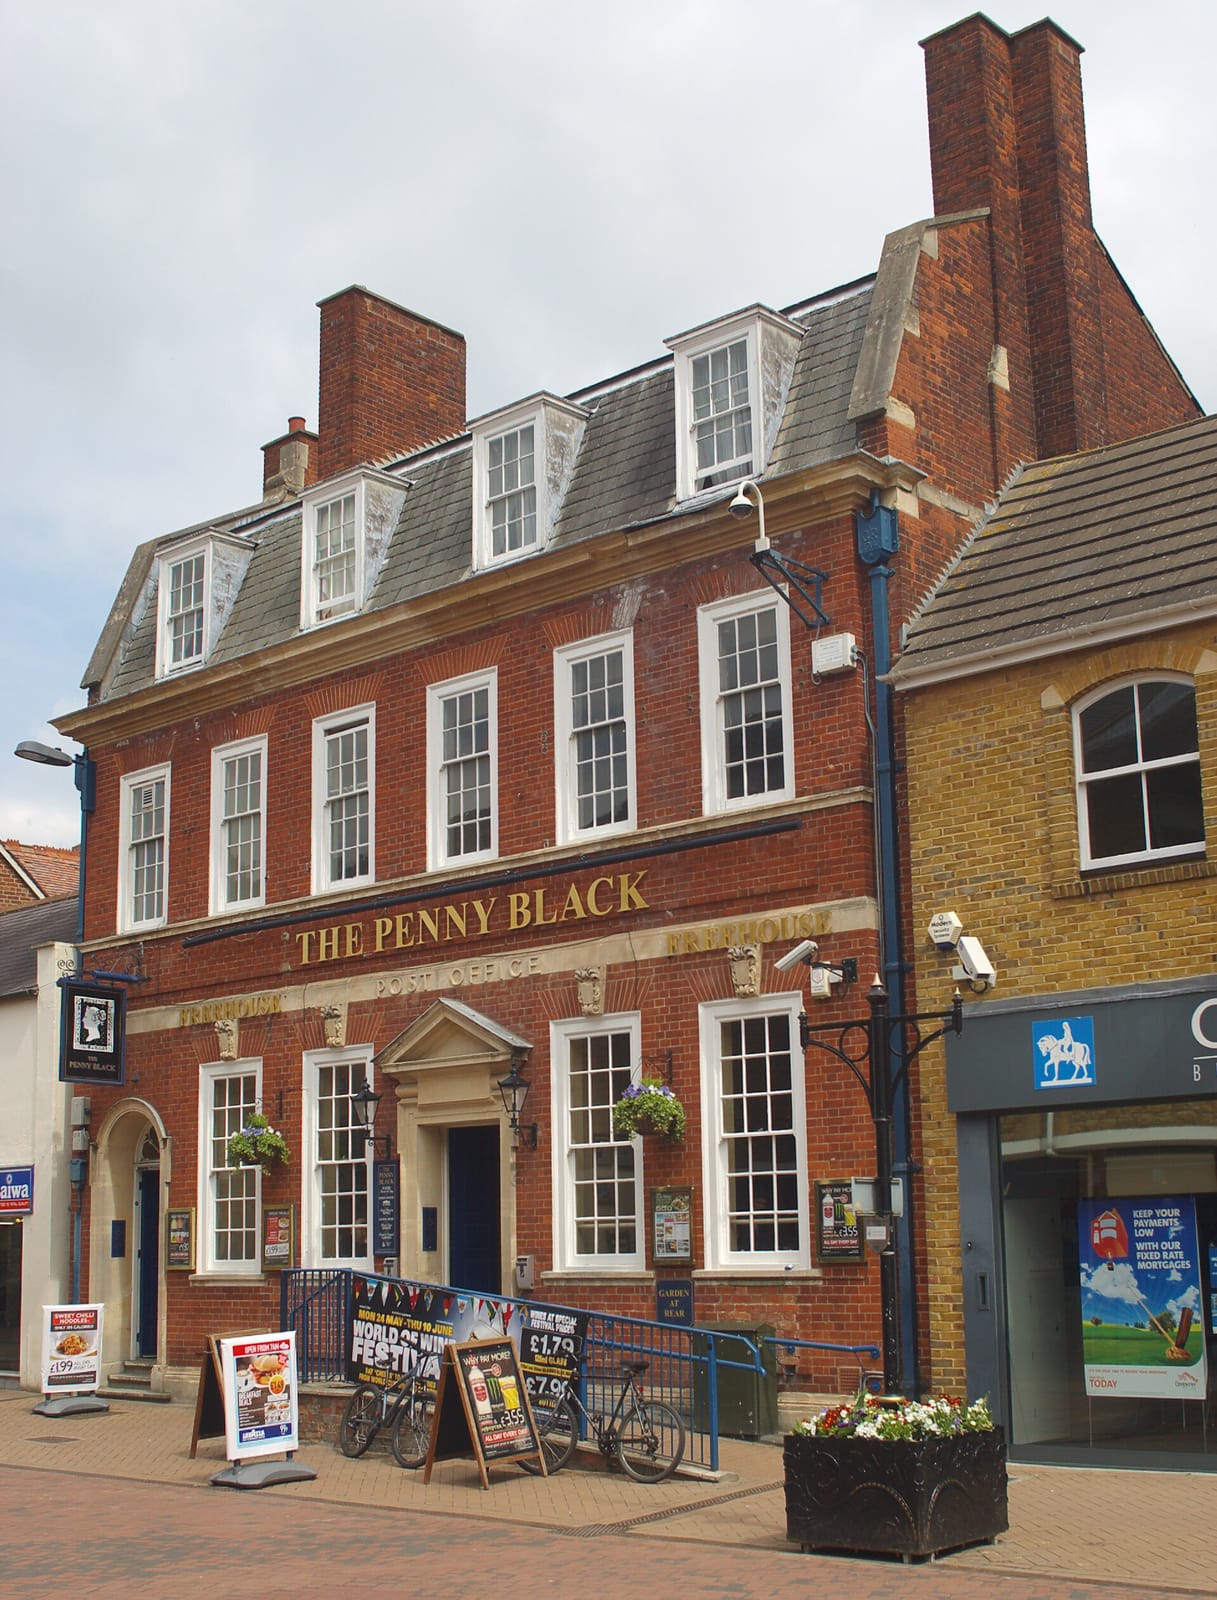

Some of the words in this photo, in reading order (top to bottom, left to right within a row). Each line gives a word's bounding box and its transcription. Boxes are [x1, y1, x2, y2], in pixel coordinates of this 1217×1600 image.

[295, 921, 365, 965] THE
[373, 897, 497, 953] PENNY
[508, 870, 650, 930] BLACK
[931, 920, 952, 928] Modern
[667, 910, 833, 955] FREEHOUSE
[376, 973, 432, 998] POST
[450, 957, 543, 986] OFFICE
[179, 993, 282, 1026] FREEHOUSE
[69, 1060, 91, 1070] PENNY
[92, 1062, 116, 1072] BLACK
[0, 1183, 29, 1199] aiwa
[1133, 1209, 1153, 1218] KEEP
[1155, 1208, 1180, 1217] YOUR
[1133, 1218, 1180, 1227] PAYMENTS
[1134, 1228, 1154, 1237] LOW
[1135, 1241, 1158, 1251] WITH
[1161, 1241, 1181, 1250] OUR
[1136, 1251, 1161, 1260] FIXED
[1162, 1251, 1184, 1260] RATE
[1137, 1260, 1191, 1270] MORTGAGES
[658, 1289, 689, 1297] GARDEN
[668, 1299, 679, 1307] AT
[664, 1309, 685, 1318] REAR
[358, 1309, 376, 1322] MON
[376, 1313, 385, 1324] 24
[385, 1314, 404, 1327] MAY
[407, 1318, 422, 1330] THU
[423, 1322, 432, 1332] 10
[432, 1322, 454, 1336] JUNE
[353, 1319, 399, 1345] WORLD
[400, 1329, 418, 1347] OF
[420, 1333, 457, 1354] WIN
[530, 1334, 575, 1356] £1.79
[351, 1336, 440, 1380] FESTIVA
[463, 1355, 479, 1366] WHY
[480, 1355, 491, 1364] PAY
[490, 1350, 511, 1361] MORE?
[50, 1360, 73, 1373] £1.99
[1089, 1379, 1118, 1388] TODAY
[501, 1408, 525, 1427] £3.55
[485, 1434, 493, 1442] ALL
[493, 1432, 502, 1441] DAY
[503, 1430, 517, 1439] EVERY
